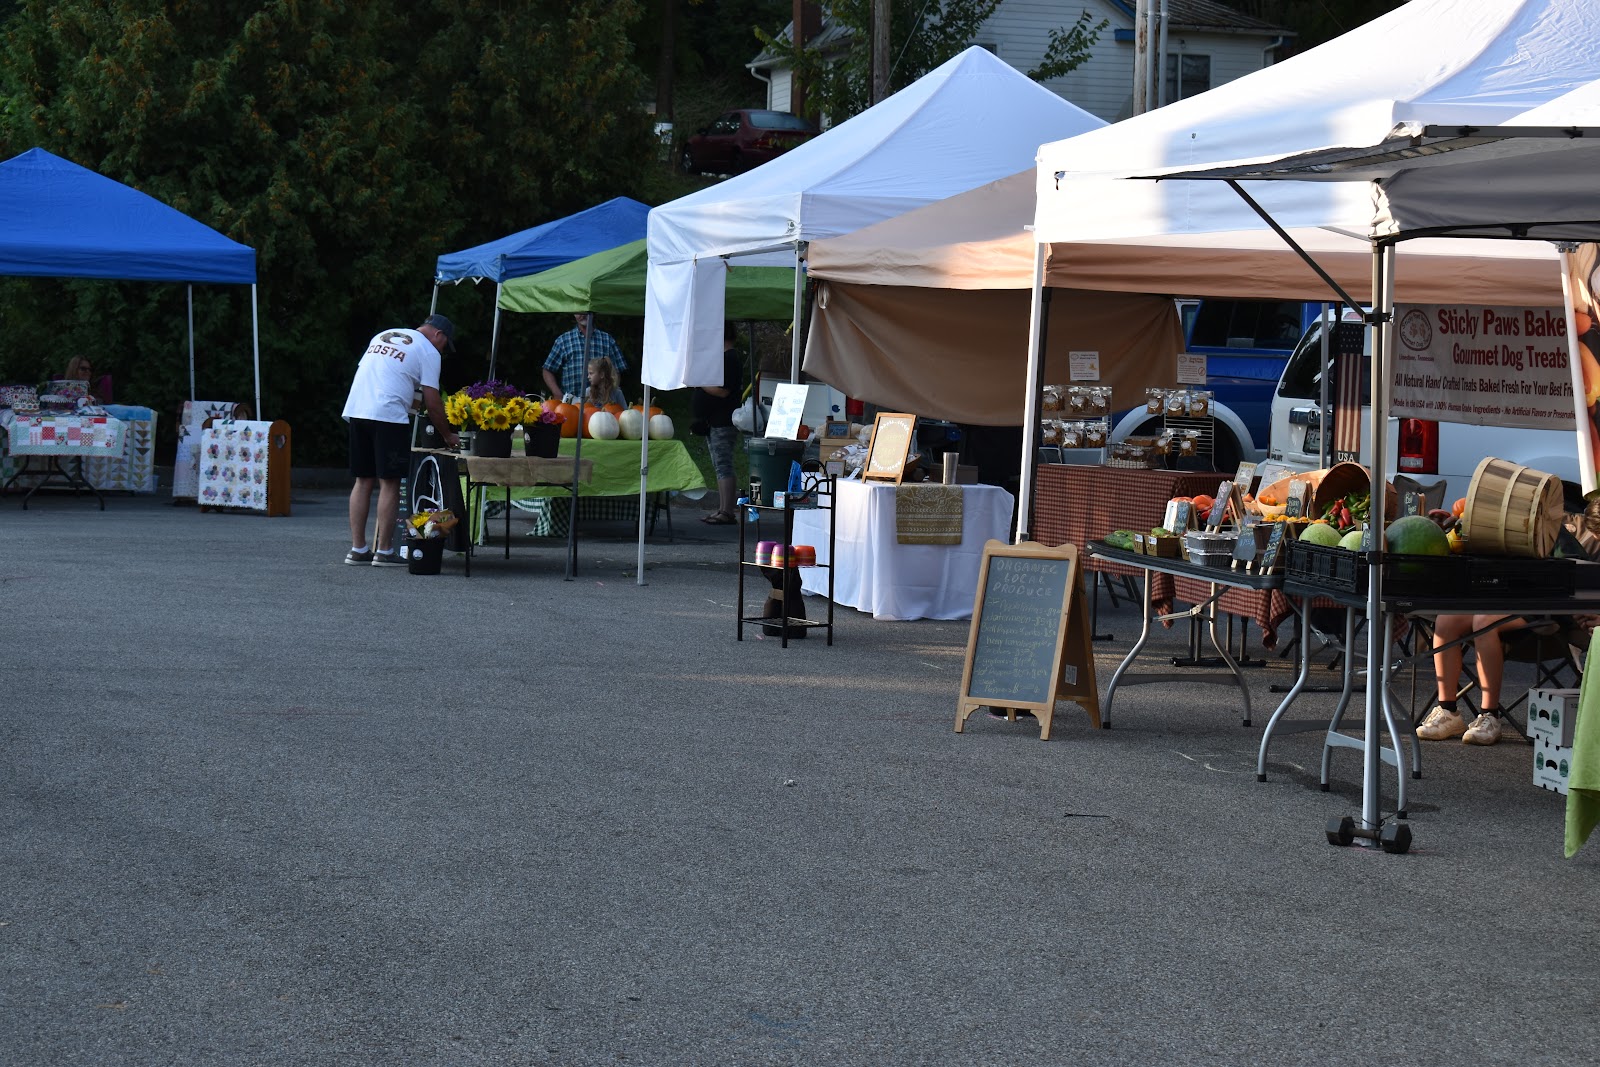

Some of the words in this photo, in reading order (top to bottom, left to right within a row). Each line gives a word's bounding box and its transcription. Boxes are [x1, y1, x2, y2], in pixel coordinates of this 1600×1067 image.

[1438, 308, 1480, 340] Sticky
[1483, 309, 1520, 337] Paws
[1524, 309, 1567, 337] Bake
[367, 344, 407, 362] COSTA
[1453, 342, 1498, 366] Gourmet
[1502, 344, 1524, 371] Dog
[1526, 345, 1568, 369] Treats
[1394, 373, 1403, 387] All
[1403, 374, 1425, 388] Natural
[1425, 375, 1442, 389] Hand
[1442, 376, 1461, 391] Crafted
[1461, 377, 1477, 392] Treats
[1479, 379, 1500, 393] Baked
[1501, 379, 1520, 394] Fresh
[1521, 380, 1532, 395] For
[1533, 381, 1548, 395] Your
[1549, 381, 1562, 397] Best
[1393, 398, 1405, 407] Made
[1416, 400, 1425, 408] USA
[1434, 401, 1447, 410] 100%
[1473, 404, 1501, 414] Ingredients
[1505, 405, 1511, 414] No
[1512, 406, 1531, 416] Artificial
[1531, 407, 1547, 417] Flavors
[1547, 410, 1553, 418] or
[1337, 451, 1356, 462] USA
[997, 559, 1058, 575] ORGANIC
[1004, 572, 1046, 585] LOCAL
[992, 581, 1054, 597] PRODUCE
